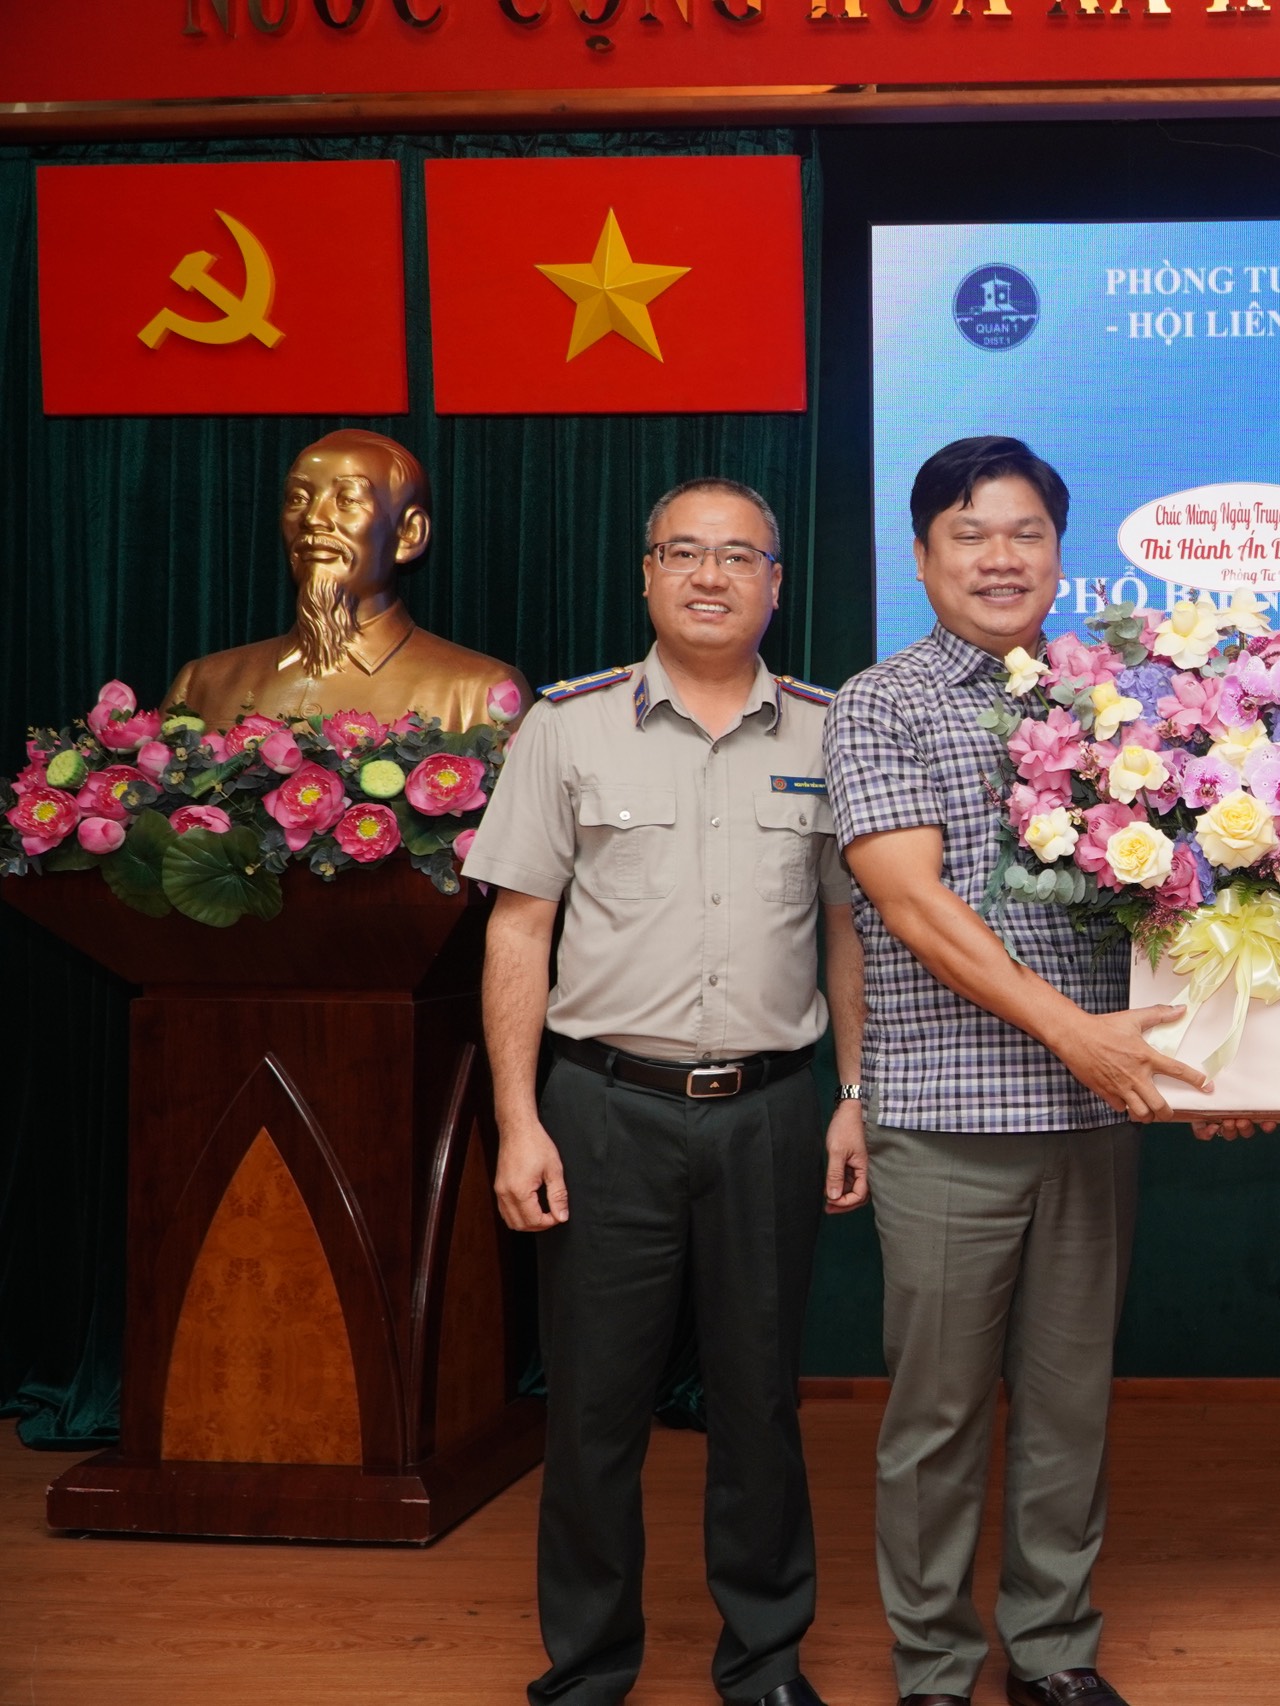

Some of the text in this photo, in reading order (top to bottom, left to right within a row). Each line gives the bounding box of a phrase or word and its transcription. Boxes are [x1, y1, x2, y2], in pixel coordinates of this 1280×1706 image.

[1105, 259, 1236, 295] PHÒNG
[1129, 307, 1195, 346] HỘI
[1156, 504, 1183, 526] Chúc
[1186, 504, 1218, 533] Mừng
[1221, 502, 1251, 531] Ngày
[1141, 538, 1174, 561] Thi
[1178, 538, 1234, 561] Hành
[1238, 530, 1268, 562] Án
[1221, 568, 1257, 585] Phòng
